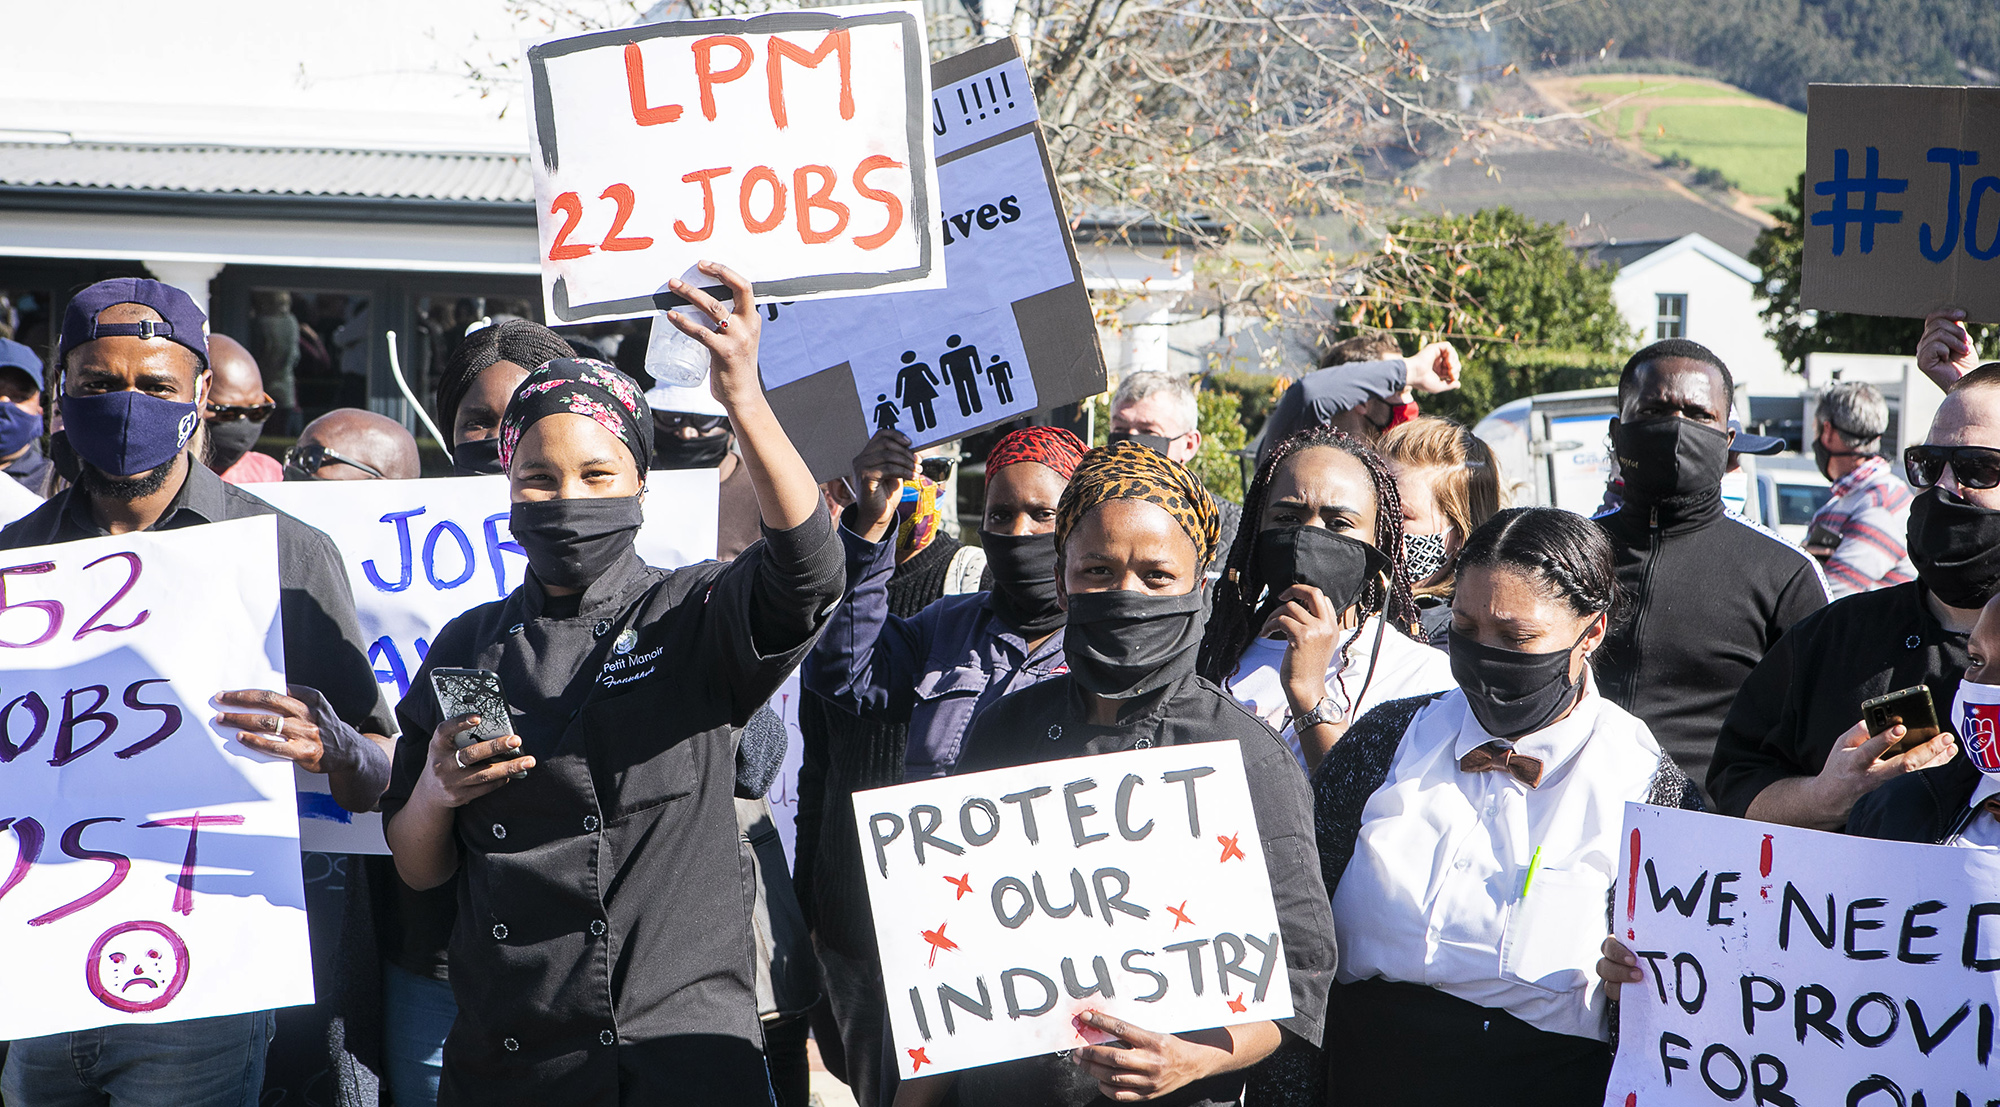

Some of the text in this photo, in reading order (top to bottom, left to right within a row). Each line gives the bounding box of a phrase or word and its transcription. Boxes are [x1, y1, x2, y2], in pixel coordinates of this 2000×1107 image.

[623, 28, 856, 130] LPM
[548, 154, 906, 262] 22 JOBS
[603, 646, 664, 673] Petit Manoir
[0, 678, 183, 767] OBS
[868, 766, 1217, 878] PROTECT
[990, 867, 1152, 930] OUR
[1644, 857, 1742, 927] WE
[1778, 880, 2000, 973] NEED
[908, 931, 1280, 1042] INDUSTRY
[1635, 950, 1995, 1069] TO PROVI
[1659, 1031, 1801, 1107] FOR
